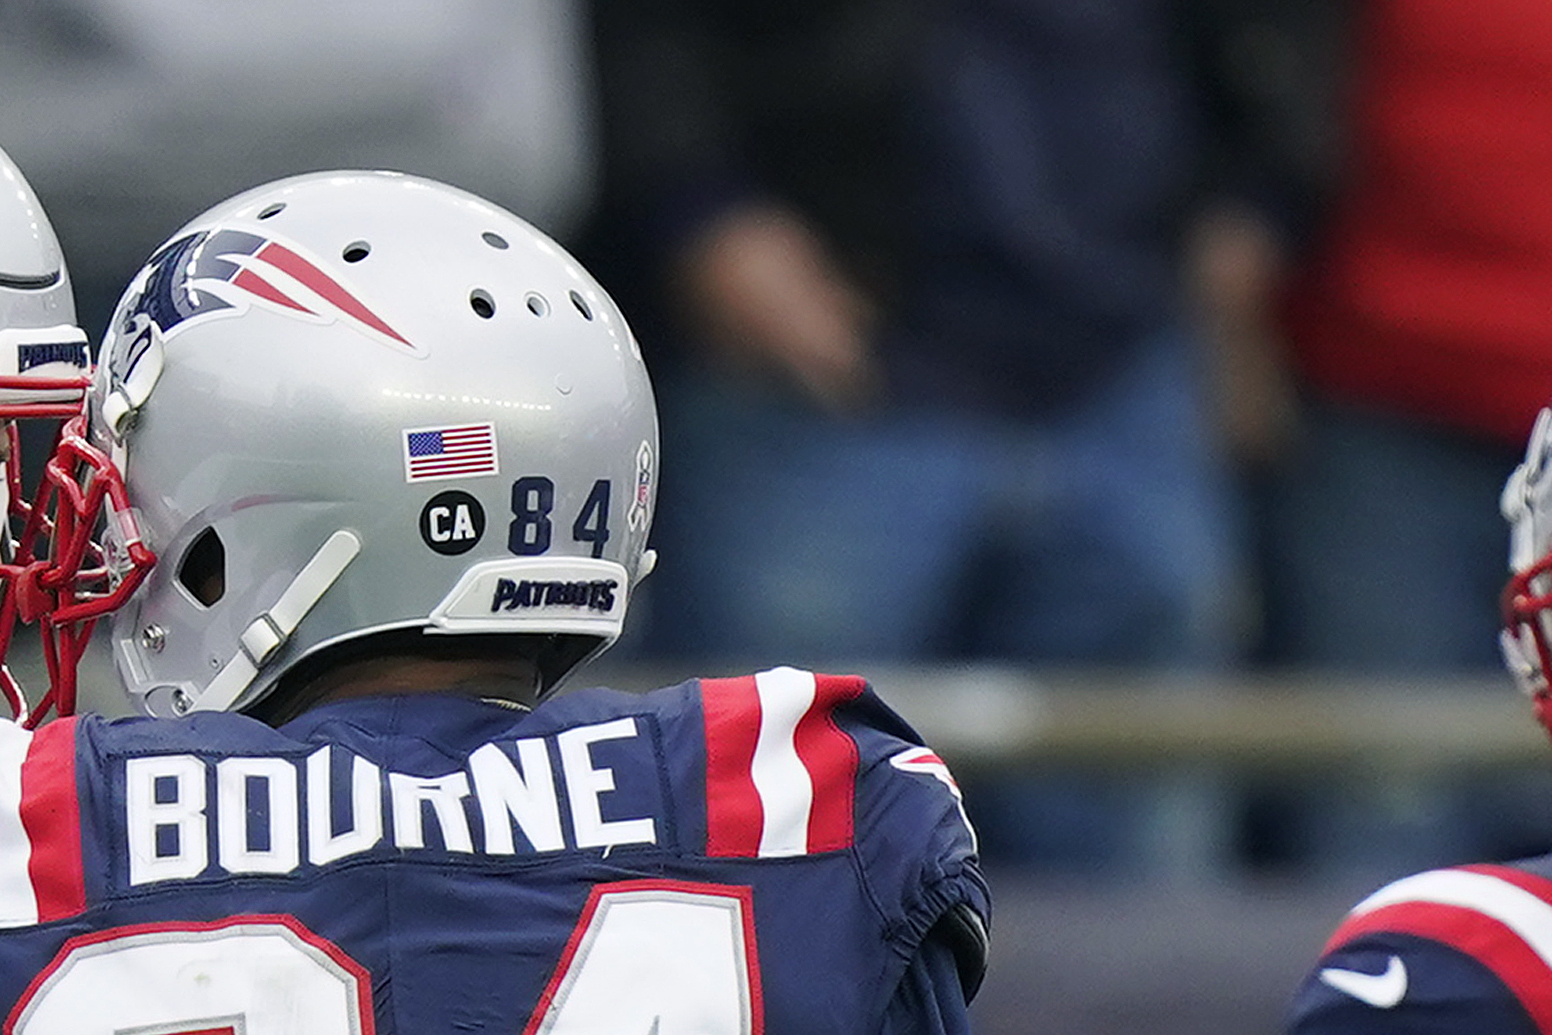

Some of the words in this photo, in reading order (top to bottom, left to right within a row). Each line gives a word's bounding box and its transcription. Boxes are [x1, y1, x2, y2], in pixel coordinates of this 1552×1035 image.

[429, 504, 476, 542] CA
[491, 578, 618, 612] PATRIOTS
[126, 717, 656, 887] BOURNE
